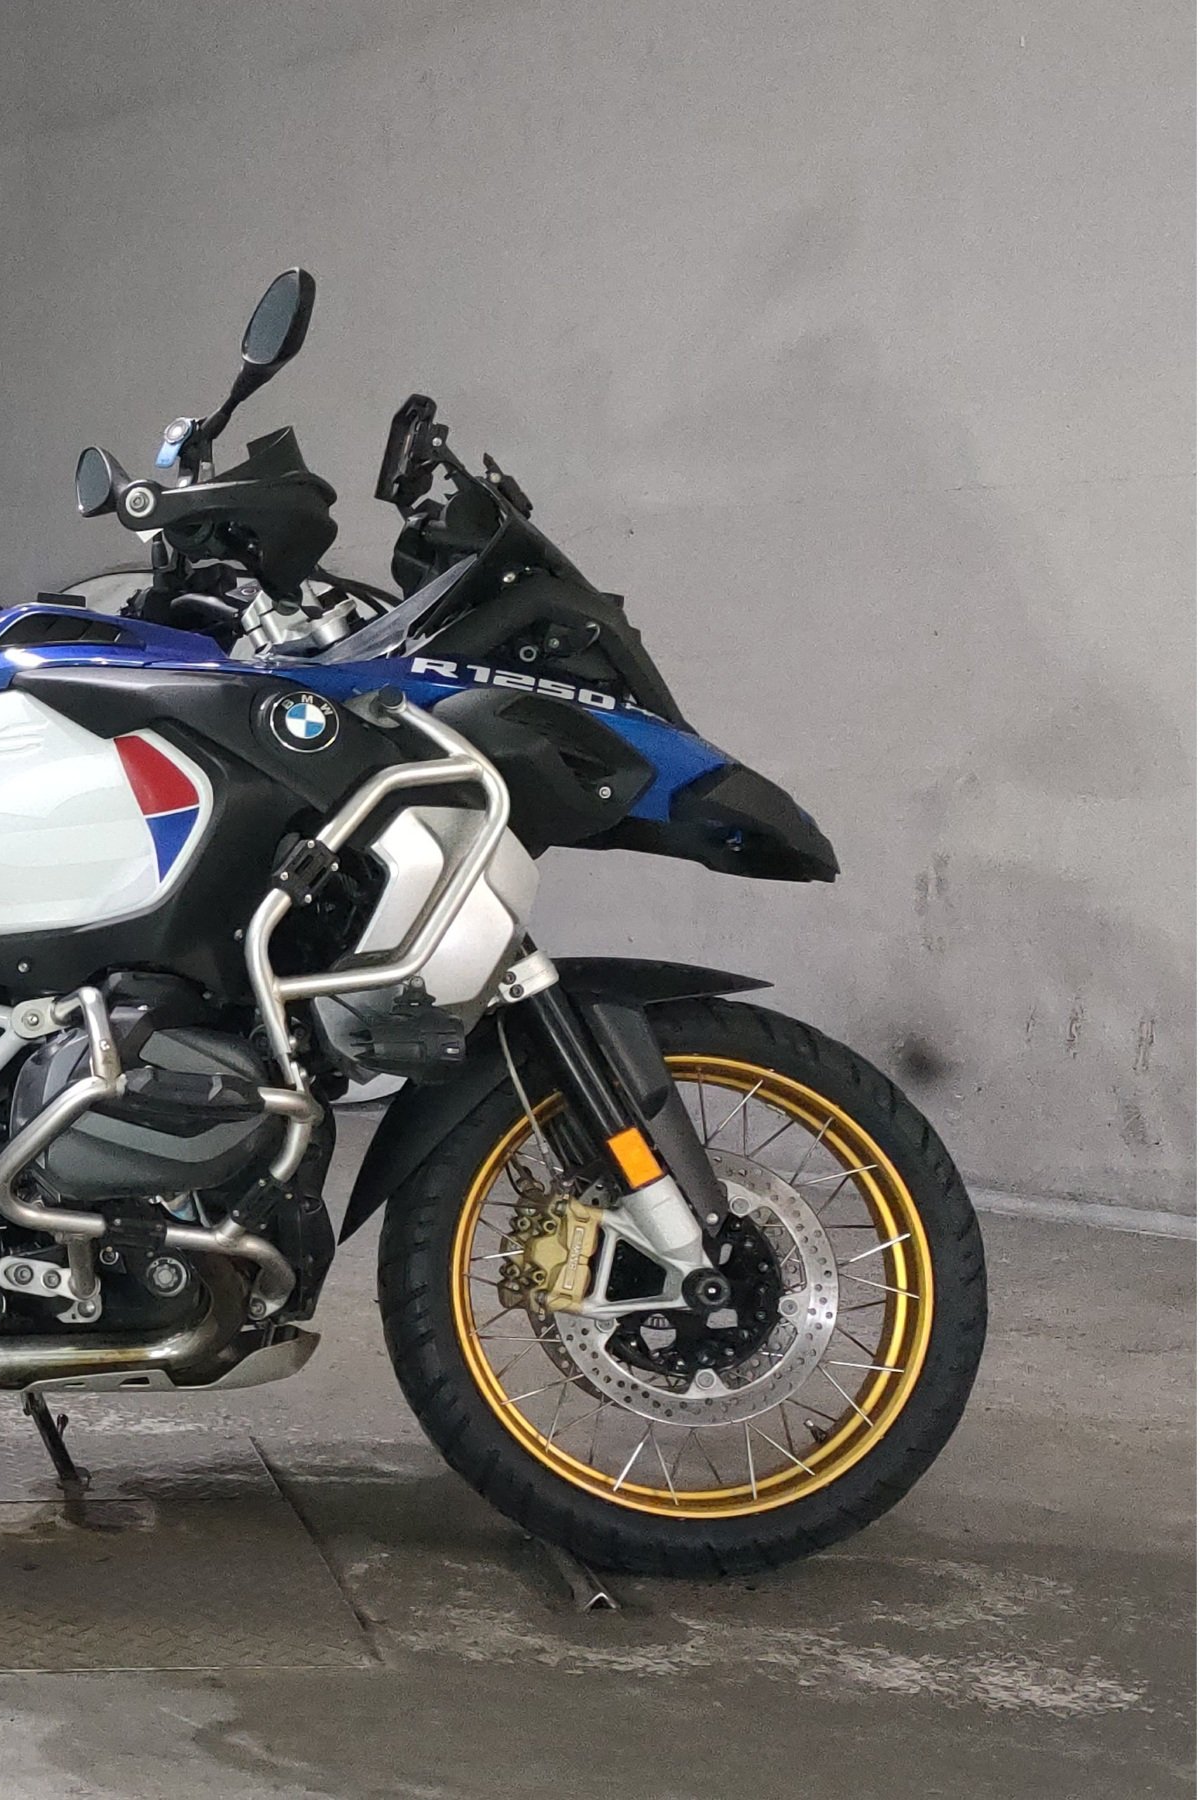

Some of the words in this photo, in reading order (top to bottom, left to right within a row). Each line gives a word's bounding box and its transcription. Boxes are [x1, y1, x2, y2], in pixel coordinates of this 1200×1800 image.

[411, 657, 458, 679] R
[466, 664, 616, 710] 1250
[281, 694, 333, 716] BMW
